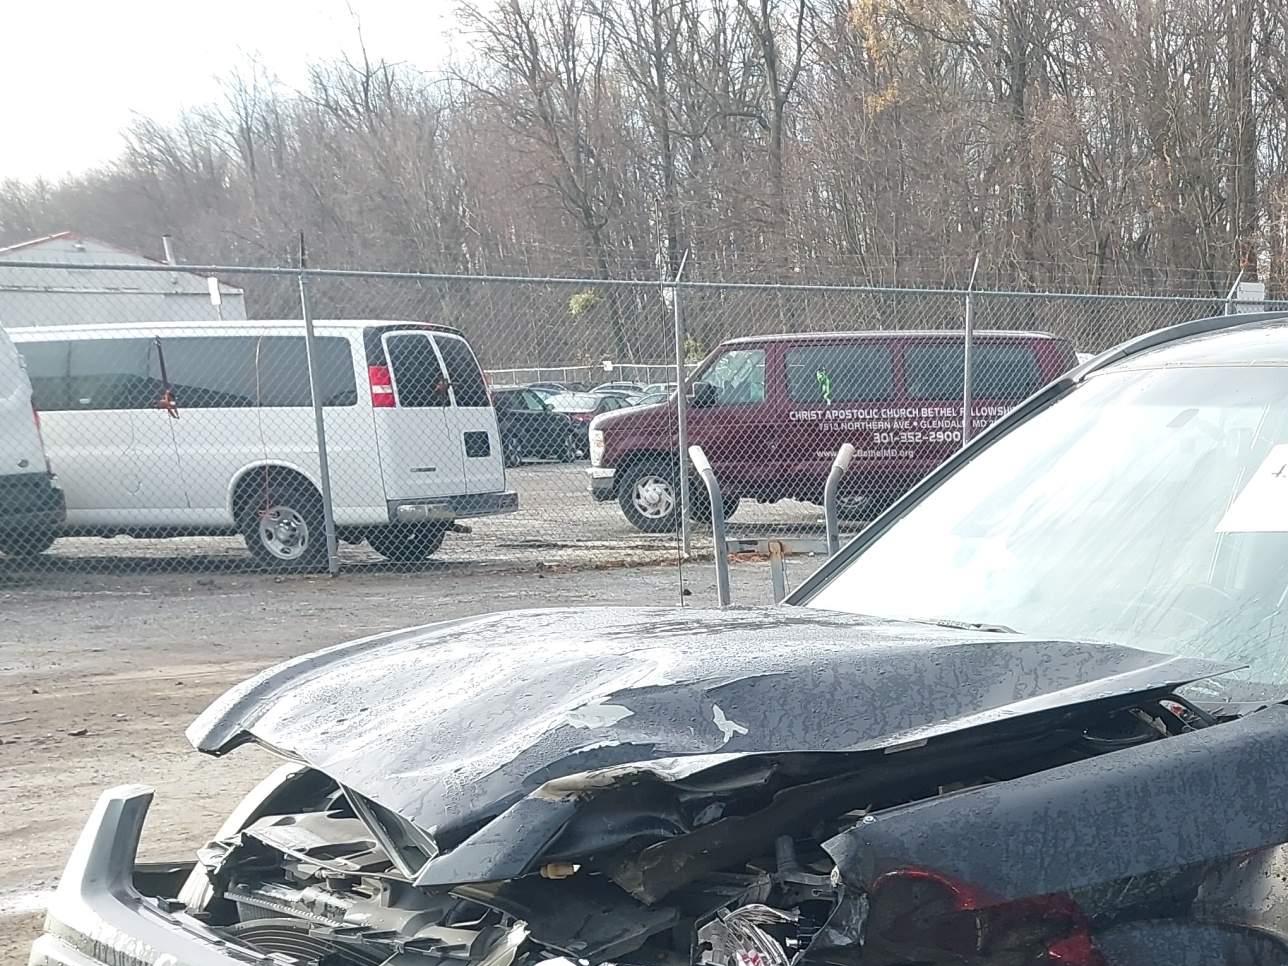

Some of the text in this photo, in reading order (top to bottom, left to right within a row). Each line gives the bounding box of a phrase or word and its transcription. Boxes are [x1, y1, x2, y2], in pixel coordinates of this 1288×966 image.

[789, 410, 824, 421] CHRIST
[825, 408, 879, 420] APOSTOLIC
[881, 407, 919, 418] CHURCH
[921, 407, 957, 417] BETHEL
[841, 421, 891, 430] NORTHERN
[972, 419, 986, 428] MD
[873, 431, 961, 443] 301-352-2900
